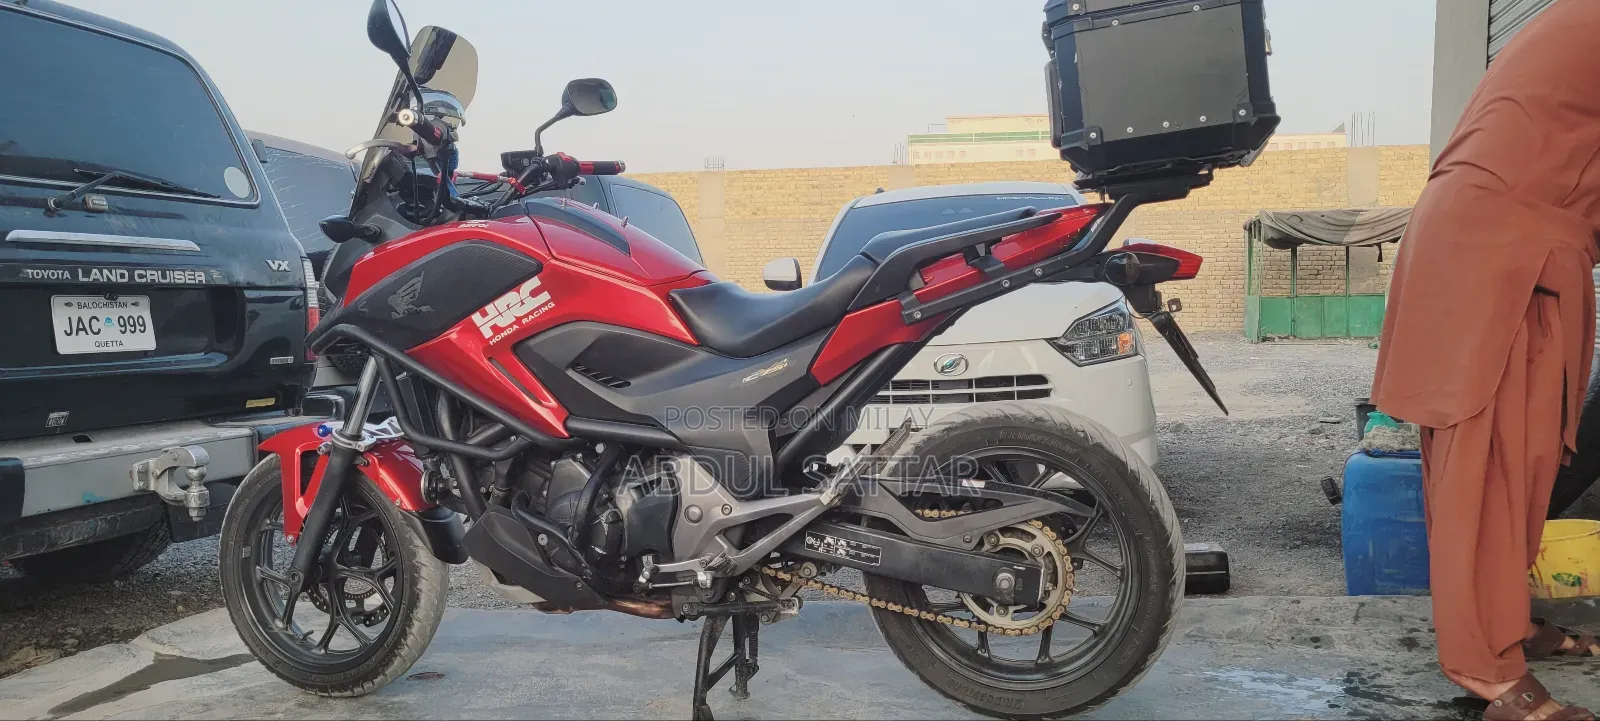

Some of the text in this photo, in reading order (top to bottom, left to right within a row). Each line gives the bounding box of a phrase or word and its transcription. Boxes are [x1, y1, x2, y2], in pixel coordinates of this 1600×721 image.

[265, 259, 291, 272] VX
[26, 268, 206, 284] TOYOTA LAND CRUISER
[77, 301, 128, 310] BALOCHISTAN
[471, 276, 552, 339] HRC
[63, 315, 147, 337] JAC 999
[489, 301, 556, 346] HONDA RACING
[94, 340, 124, 348] QUETTA
